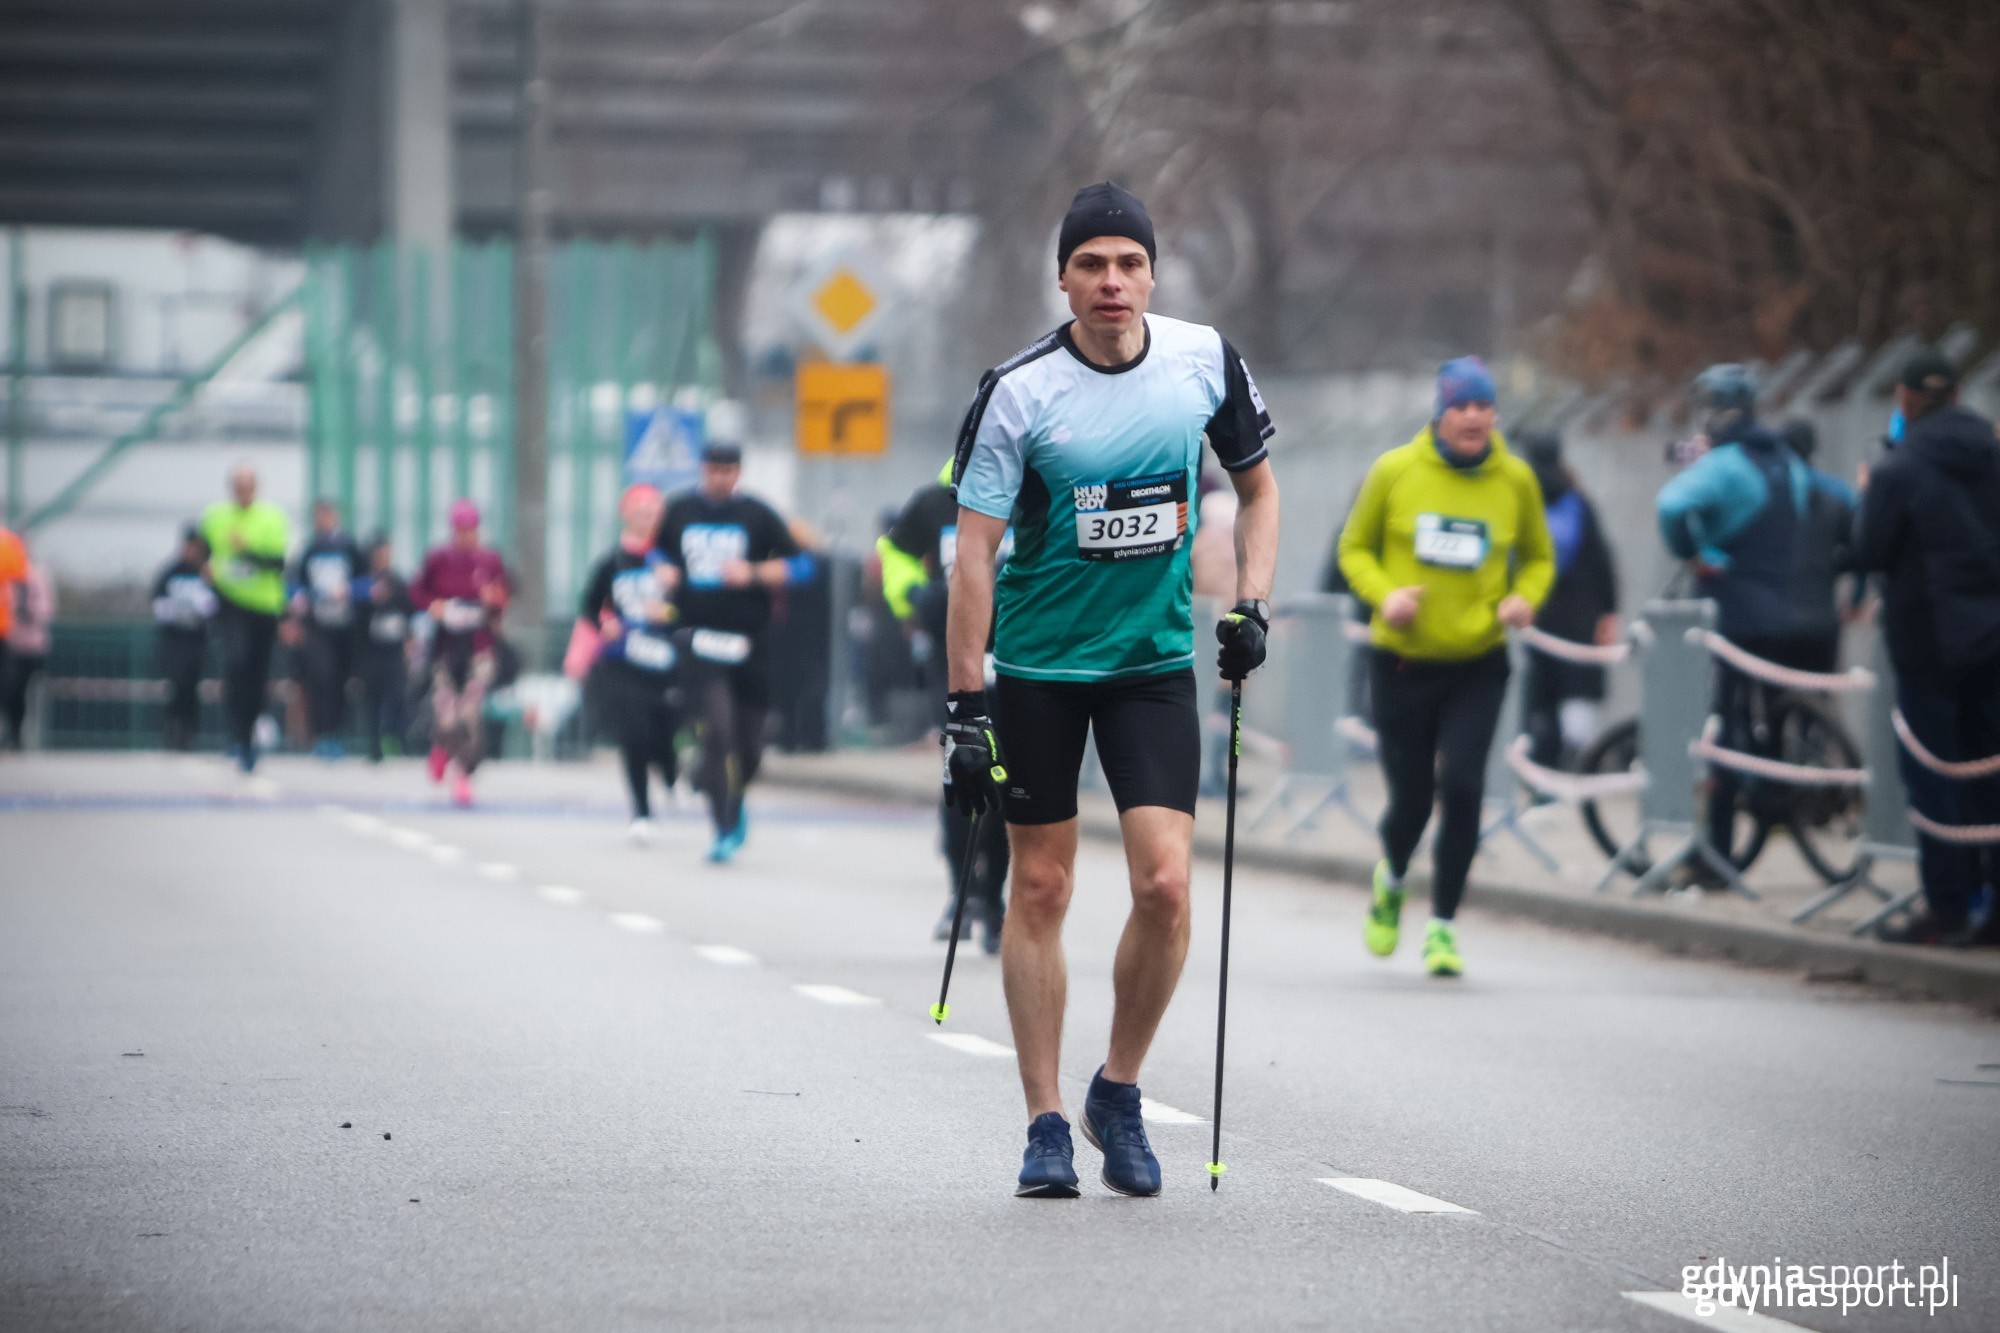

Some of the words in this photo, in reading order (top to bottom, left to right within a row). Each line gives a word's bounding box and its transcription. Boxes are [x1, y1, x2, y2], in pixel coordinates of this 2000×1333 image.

[1073, 484, 1108, 499] RUN
[1130, 484, 1171, 498] DECATHLON
[1074, 497, 1107, 511] GDY
[1088, 512, 1159, 541] 3032
[1113, 544, 1166, 559] gdyniasport.pl
